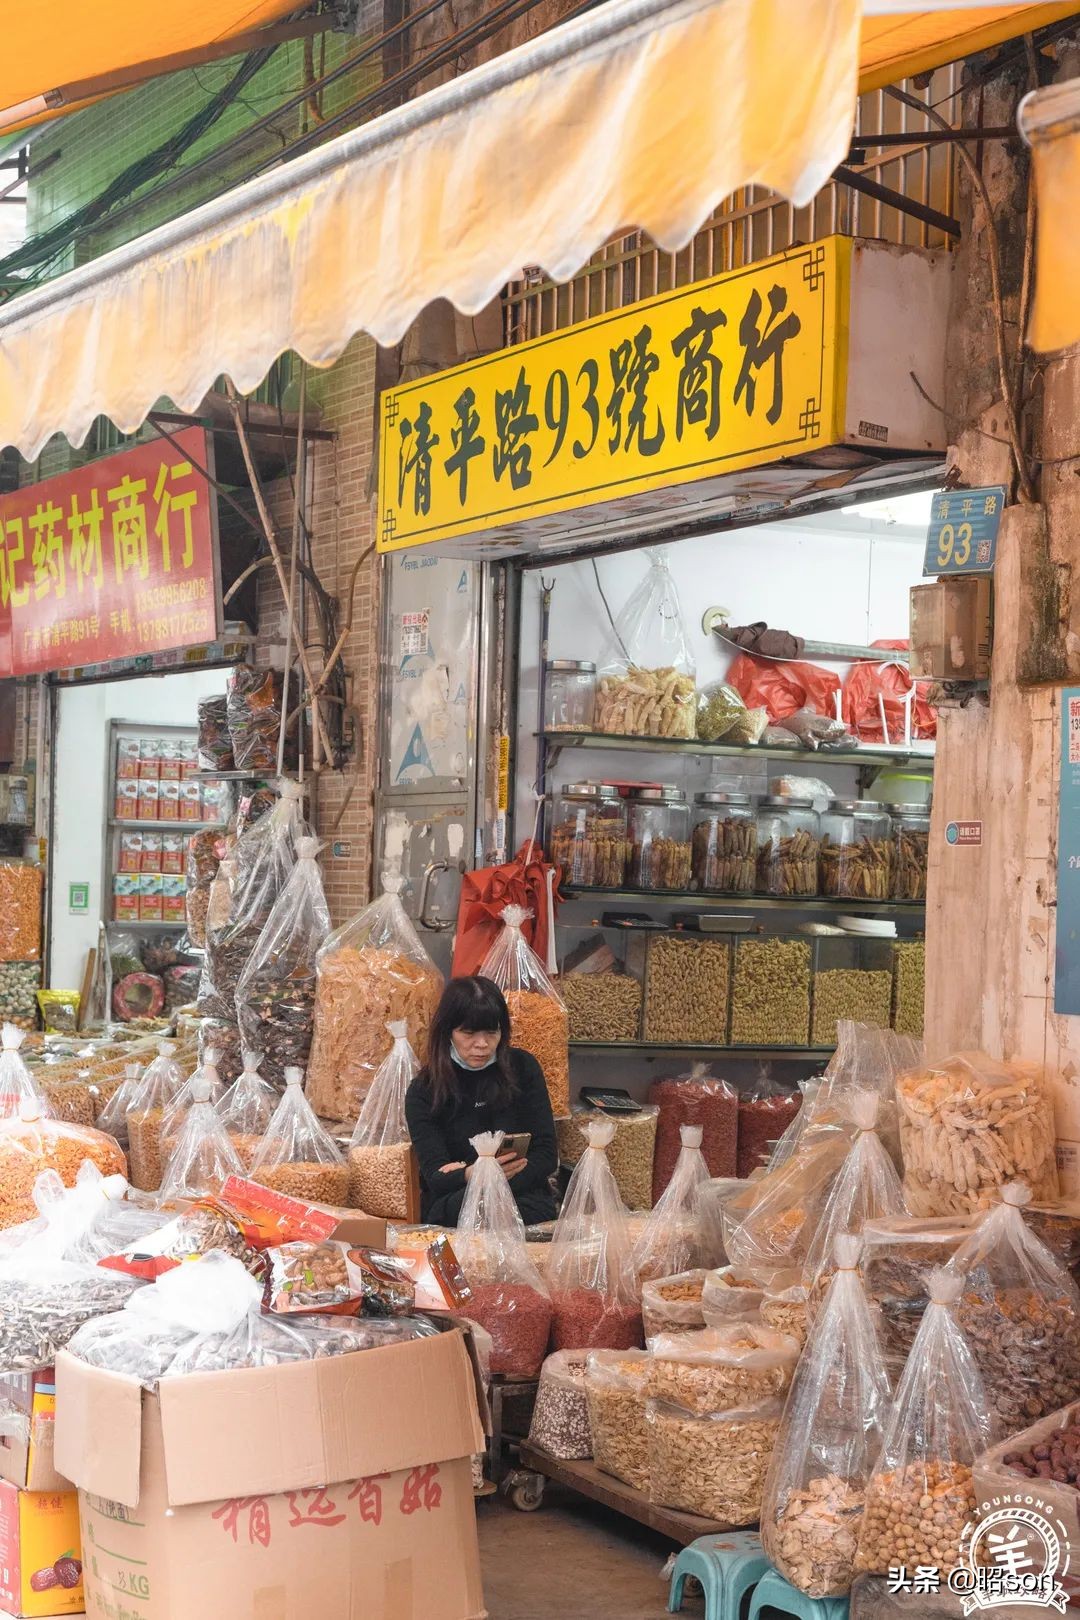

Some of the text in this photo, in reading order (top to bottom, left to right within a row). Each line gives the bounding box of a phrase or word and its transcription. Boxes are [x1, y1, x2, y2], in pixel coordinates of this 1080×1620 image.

[398, 284, 801, 517] 清平路93號商行
[937, 495, 997, 519] 清平路
[937, 522, 973, 567] 93
[128, 1572, 150, 1596] KG
